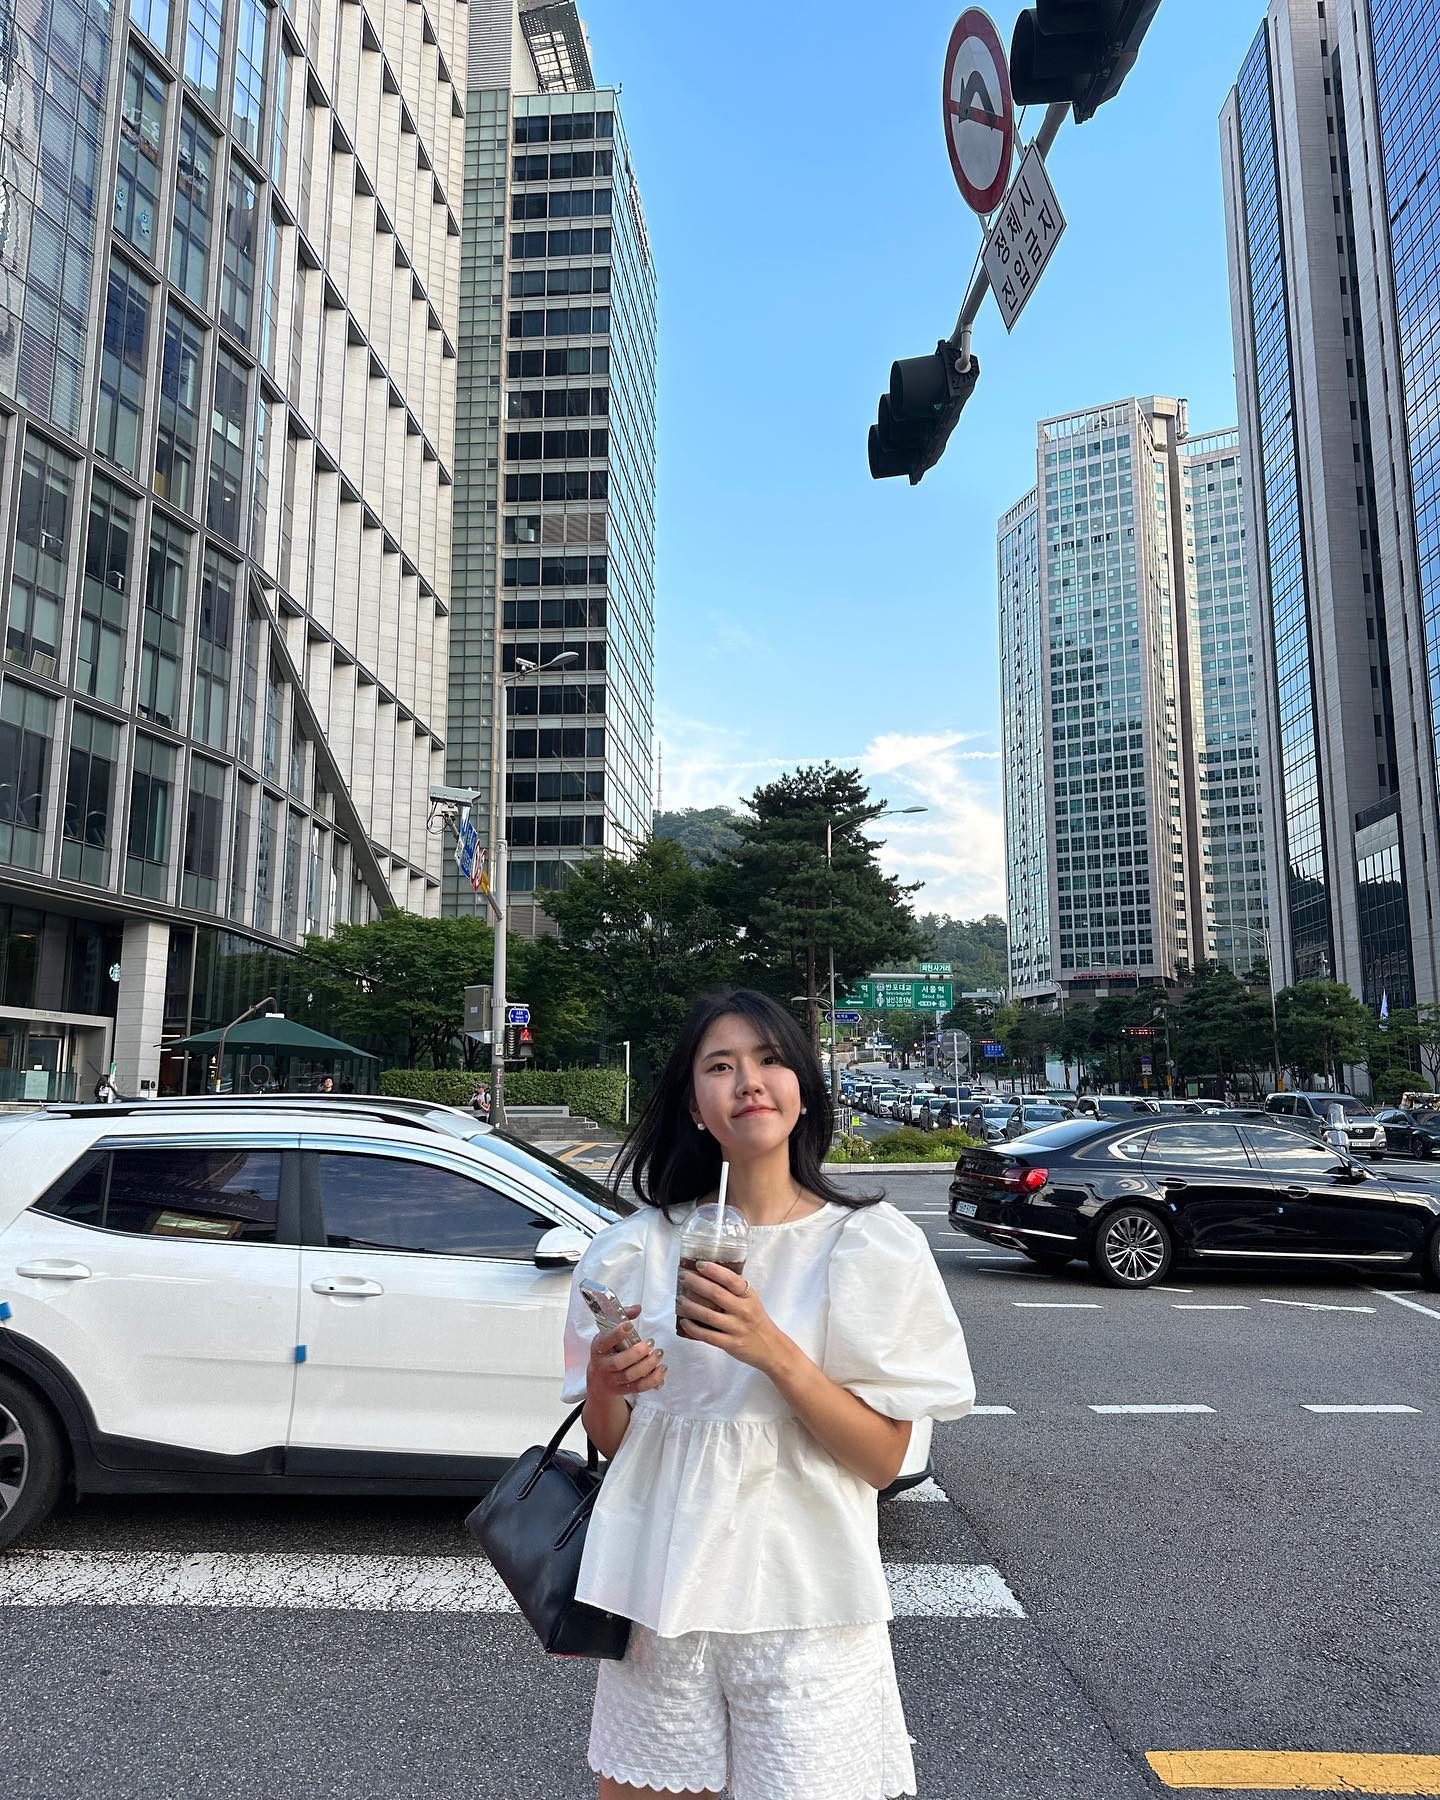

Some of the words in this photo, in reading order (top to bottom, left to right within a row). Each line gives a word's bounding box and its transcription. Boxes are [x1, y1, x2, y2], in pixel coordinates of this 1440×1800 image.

[994, 174, 1036, 265] 정체시
[1001, 198, 1056, 312] 진입금지
[885, 983, 912, 991] 반포대교
[921, 985, 945, 994] 서울역
